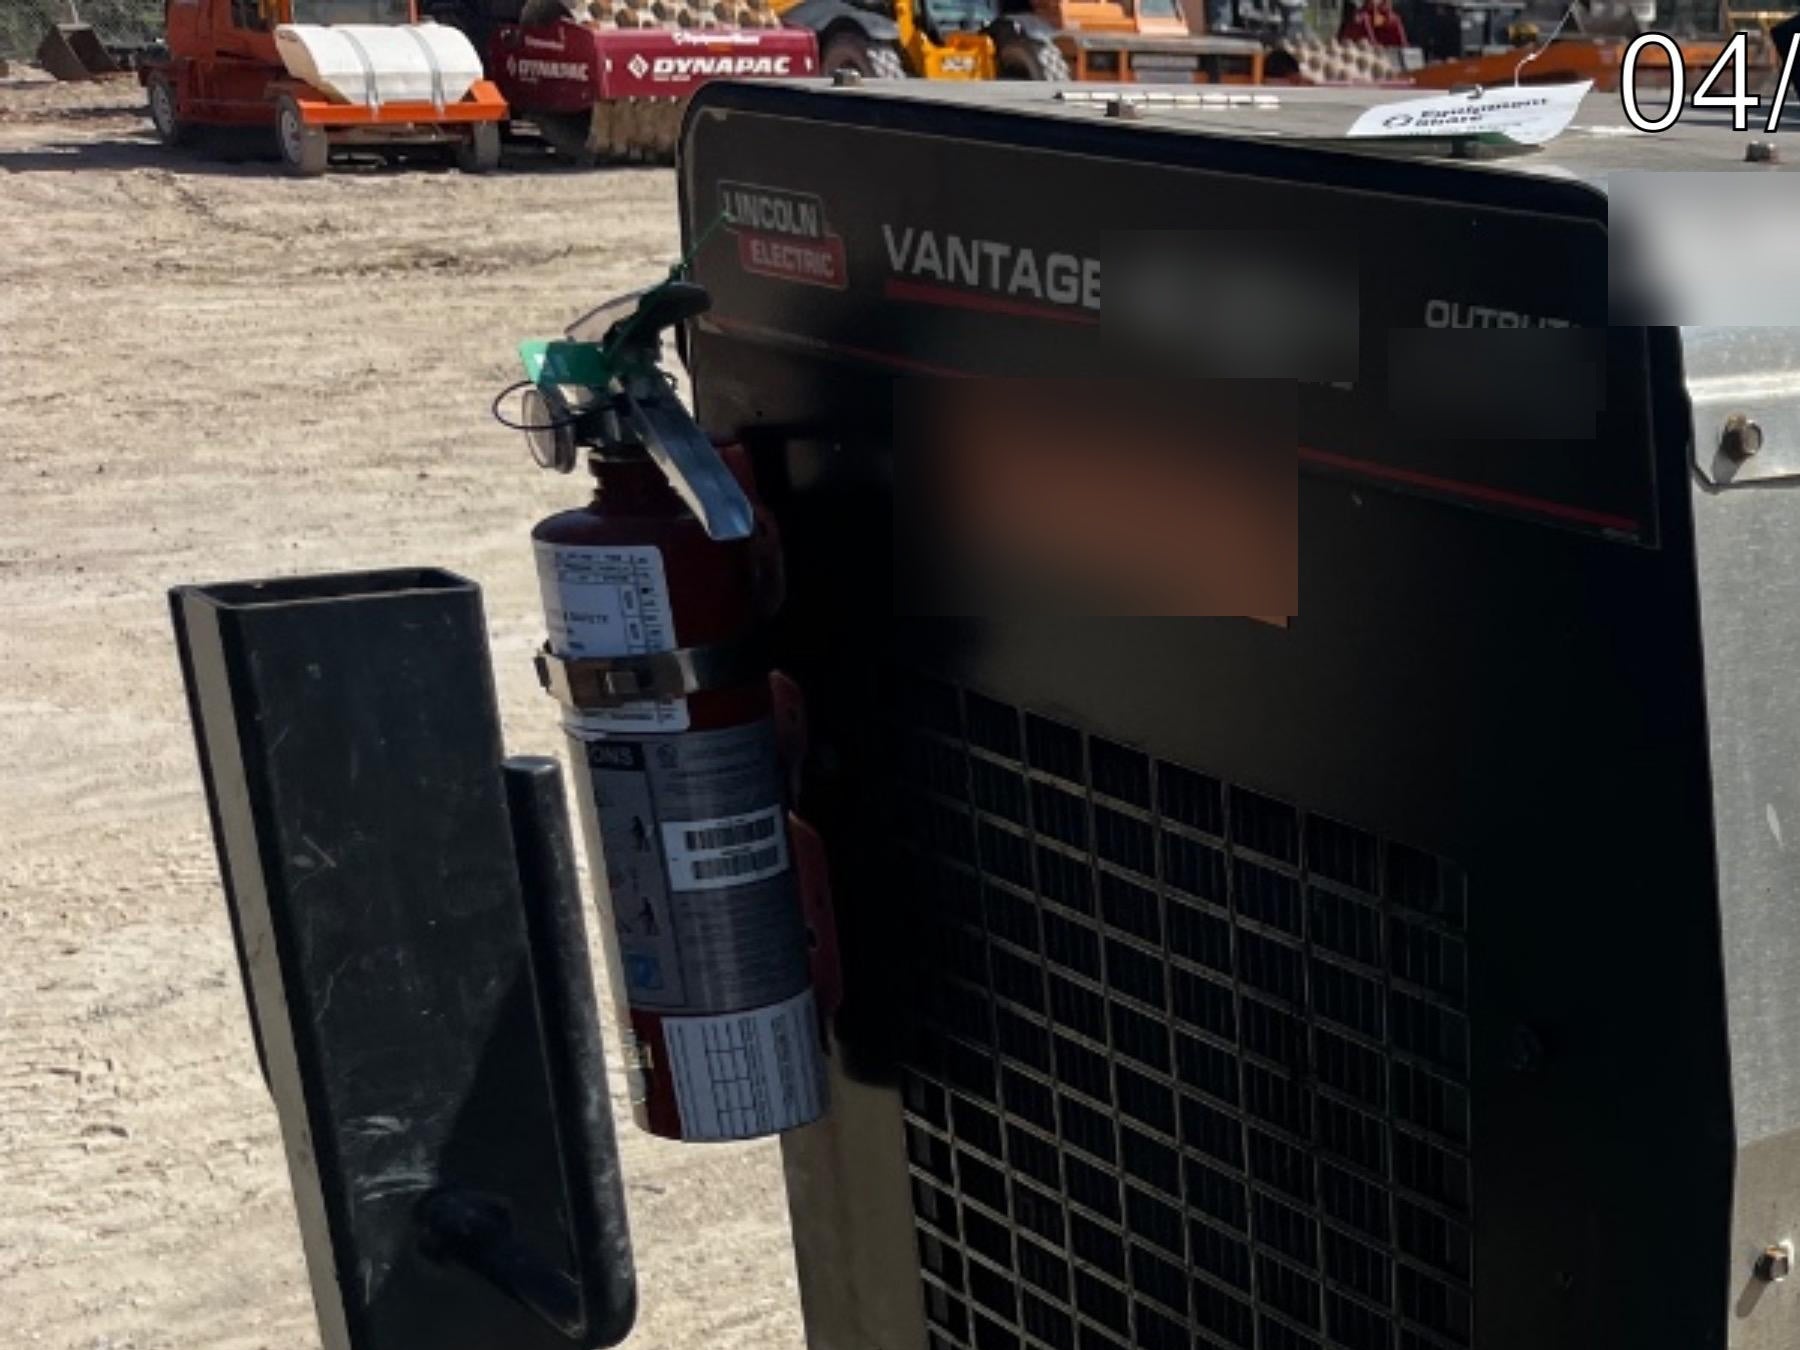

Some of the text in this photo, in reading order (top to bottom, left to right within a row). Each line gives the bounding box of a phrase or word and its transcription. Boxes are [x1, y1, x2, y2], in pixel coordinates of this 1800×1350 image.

[653, 57, 790, 75] DYNAPAC
[723, 191, 826, 238] LINCOLN
[749, 239, 834, 278] ELECTRIC
[882, 224, 1101, 310] VANTAGE
